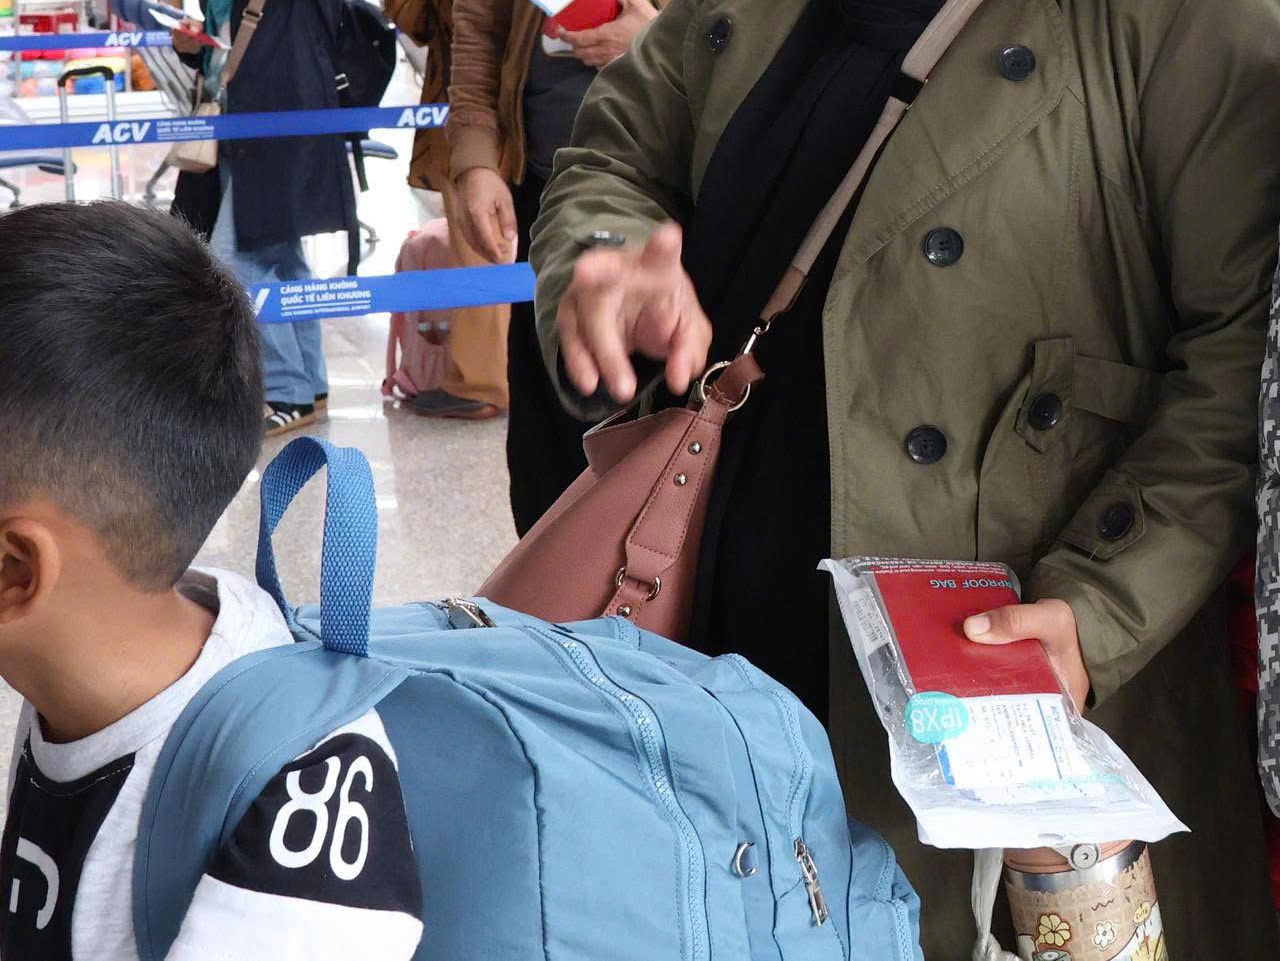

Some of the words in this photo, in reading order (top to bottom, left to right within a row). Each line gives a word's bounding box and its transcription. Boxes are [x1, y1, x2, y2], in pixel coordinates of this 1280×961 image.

[104, 32, 143, 47] ACV
[397, 106, 449, 127] ACV
[92, 121, 151, 144] ACV
[930, 579, 956, 588] BAG
[910, 706, 962, 733] IPX8
[269, 755, 374, 881] 86
